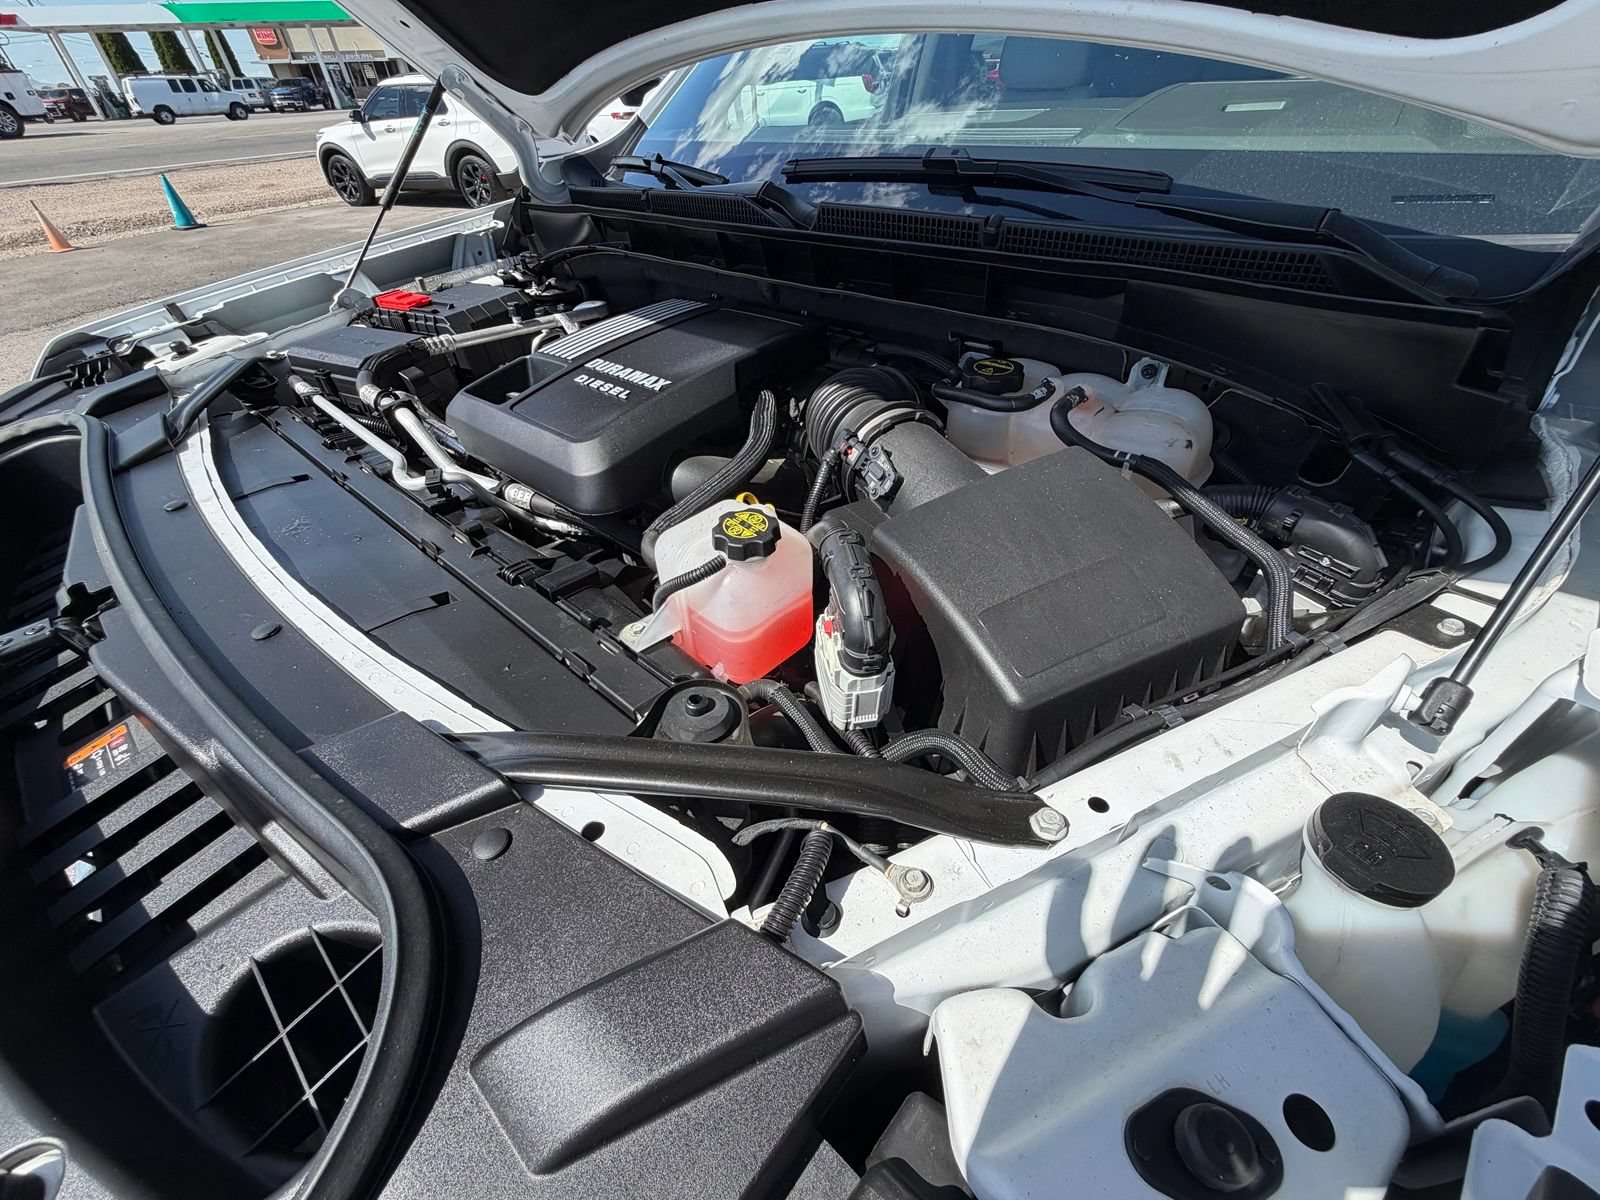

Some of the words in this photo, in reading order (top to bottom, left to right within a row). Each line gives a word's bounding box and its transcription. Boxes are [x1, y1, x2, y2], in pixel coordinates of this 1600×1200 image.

[256, 31, 276, 40] KING
[573, 374, 631, 400] DIESEL
[584, 358, 672, 391] DURAMAX
